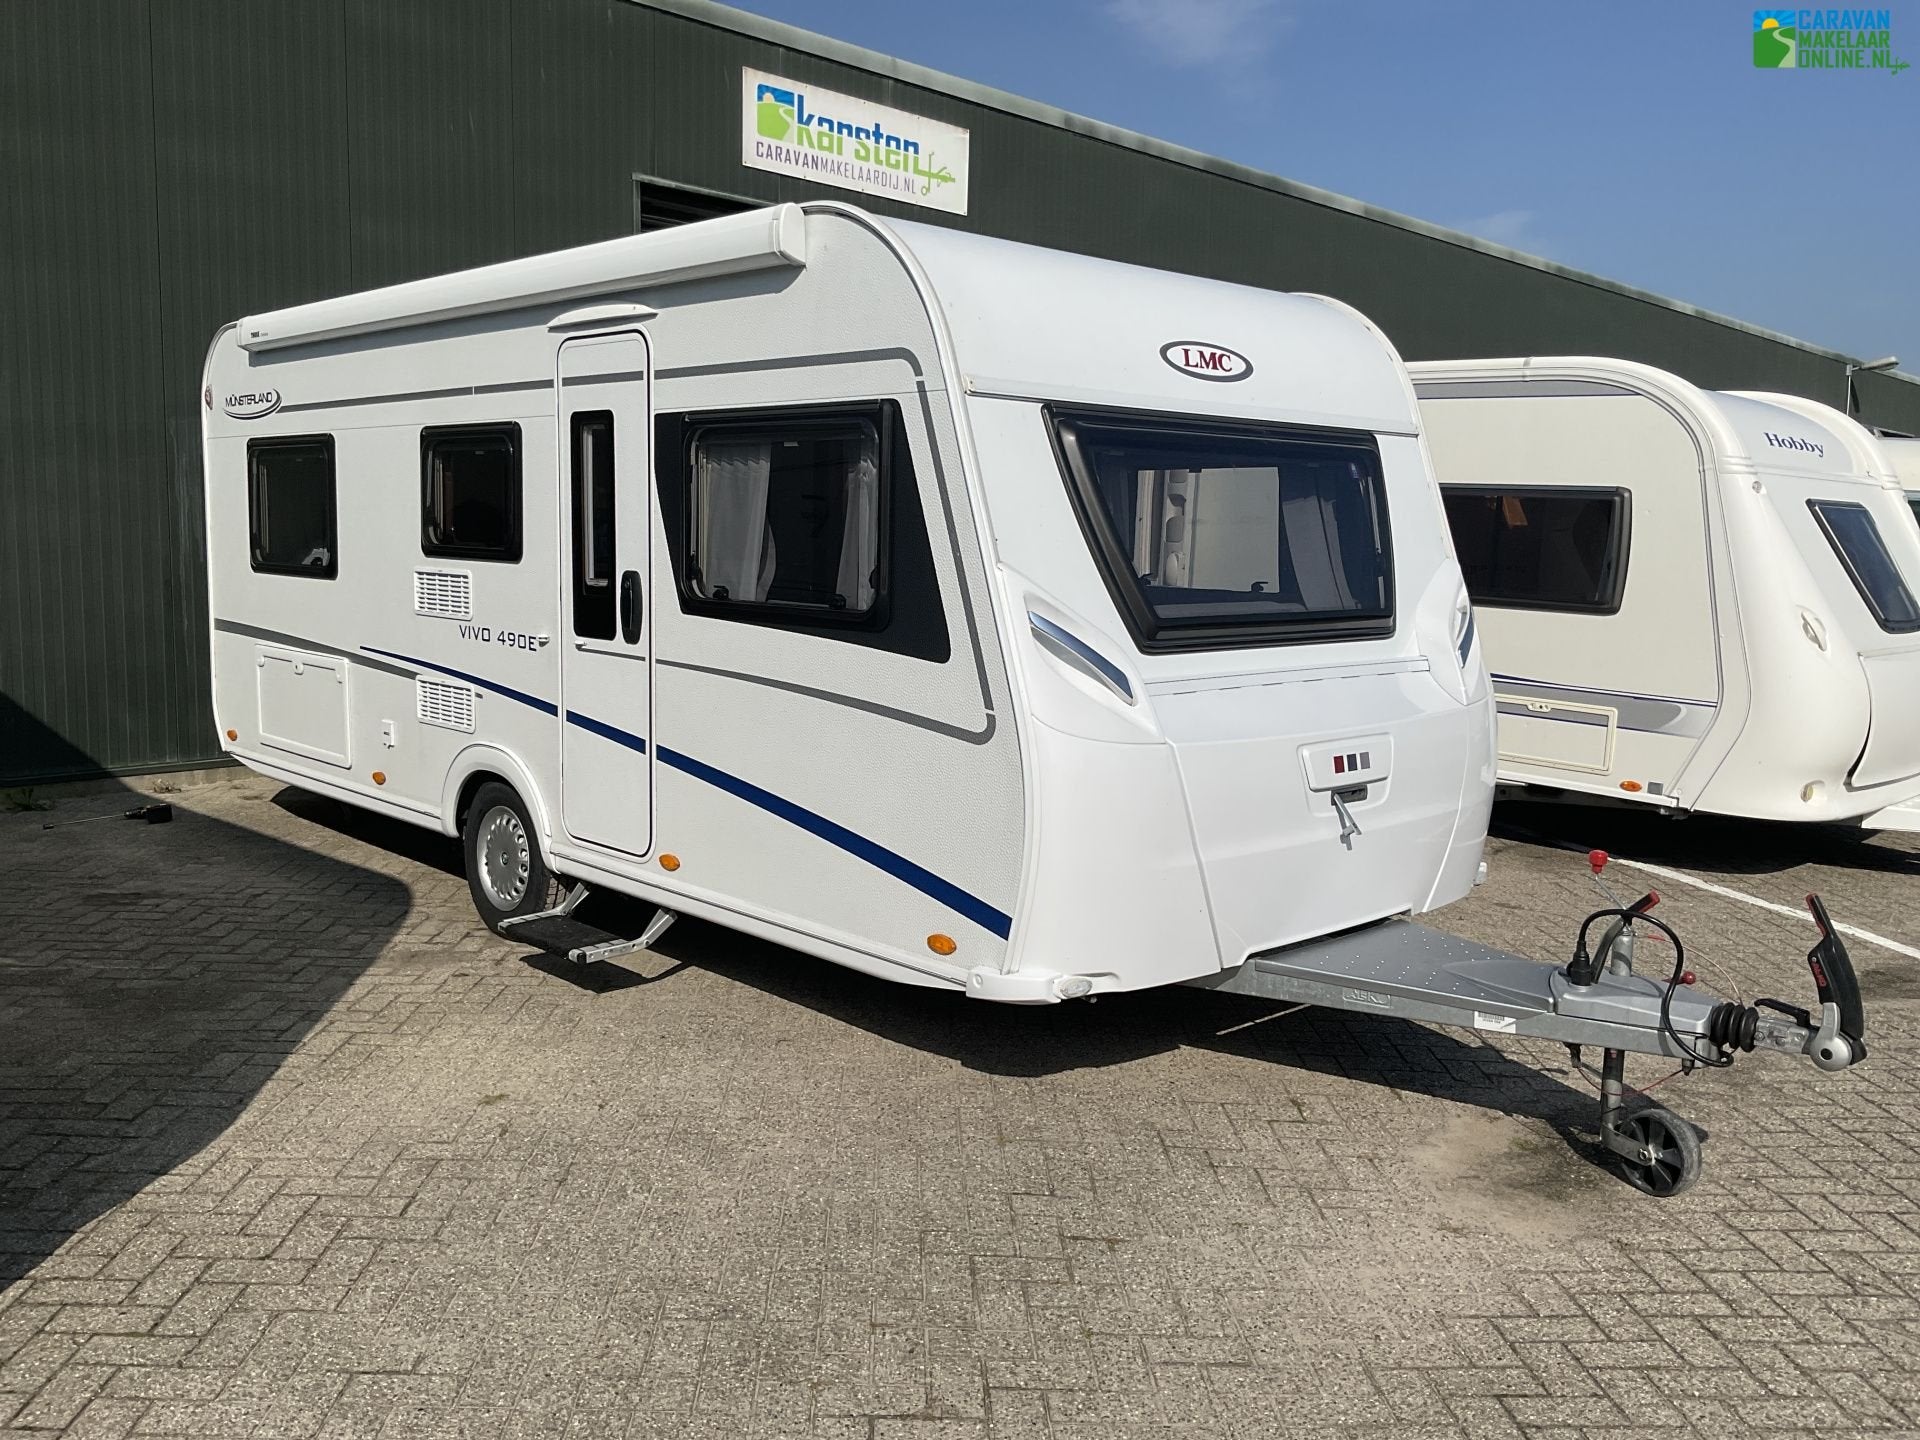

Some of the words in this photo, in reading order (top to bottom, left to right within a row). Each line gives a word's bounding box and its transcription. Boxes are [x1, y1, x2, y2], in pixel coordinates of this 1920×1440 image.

[797, 94, 921, 174] karsten
[756, 141, 916, 194] CARAVANMAKELAARDIJ.NL
[1181, 348, 1232, 372] LMC
[225, 392, 272, 407] MÜNSTERLAND
[1763, 432, 1824, 457] Hobby
[459, 625, 491, 642] VIVO
[497, 631, 537, 651] 490E
